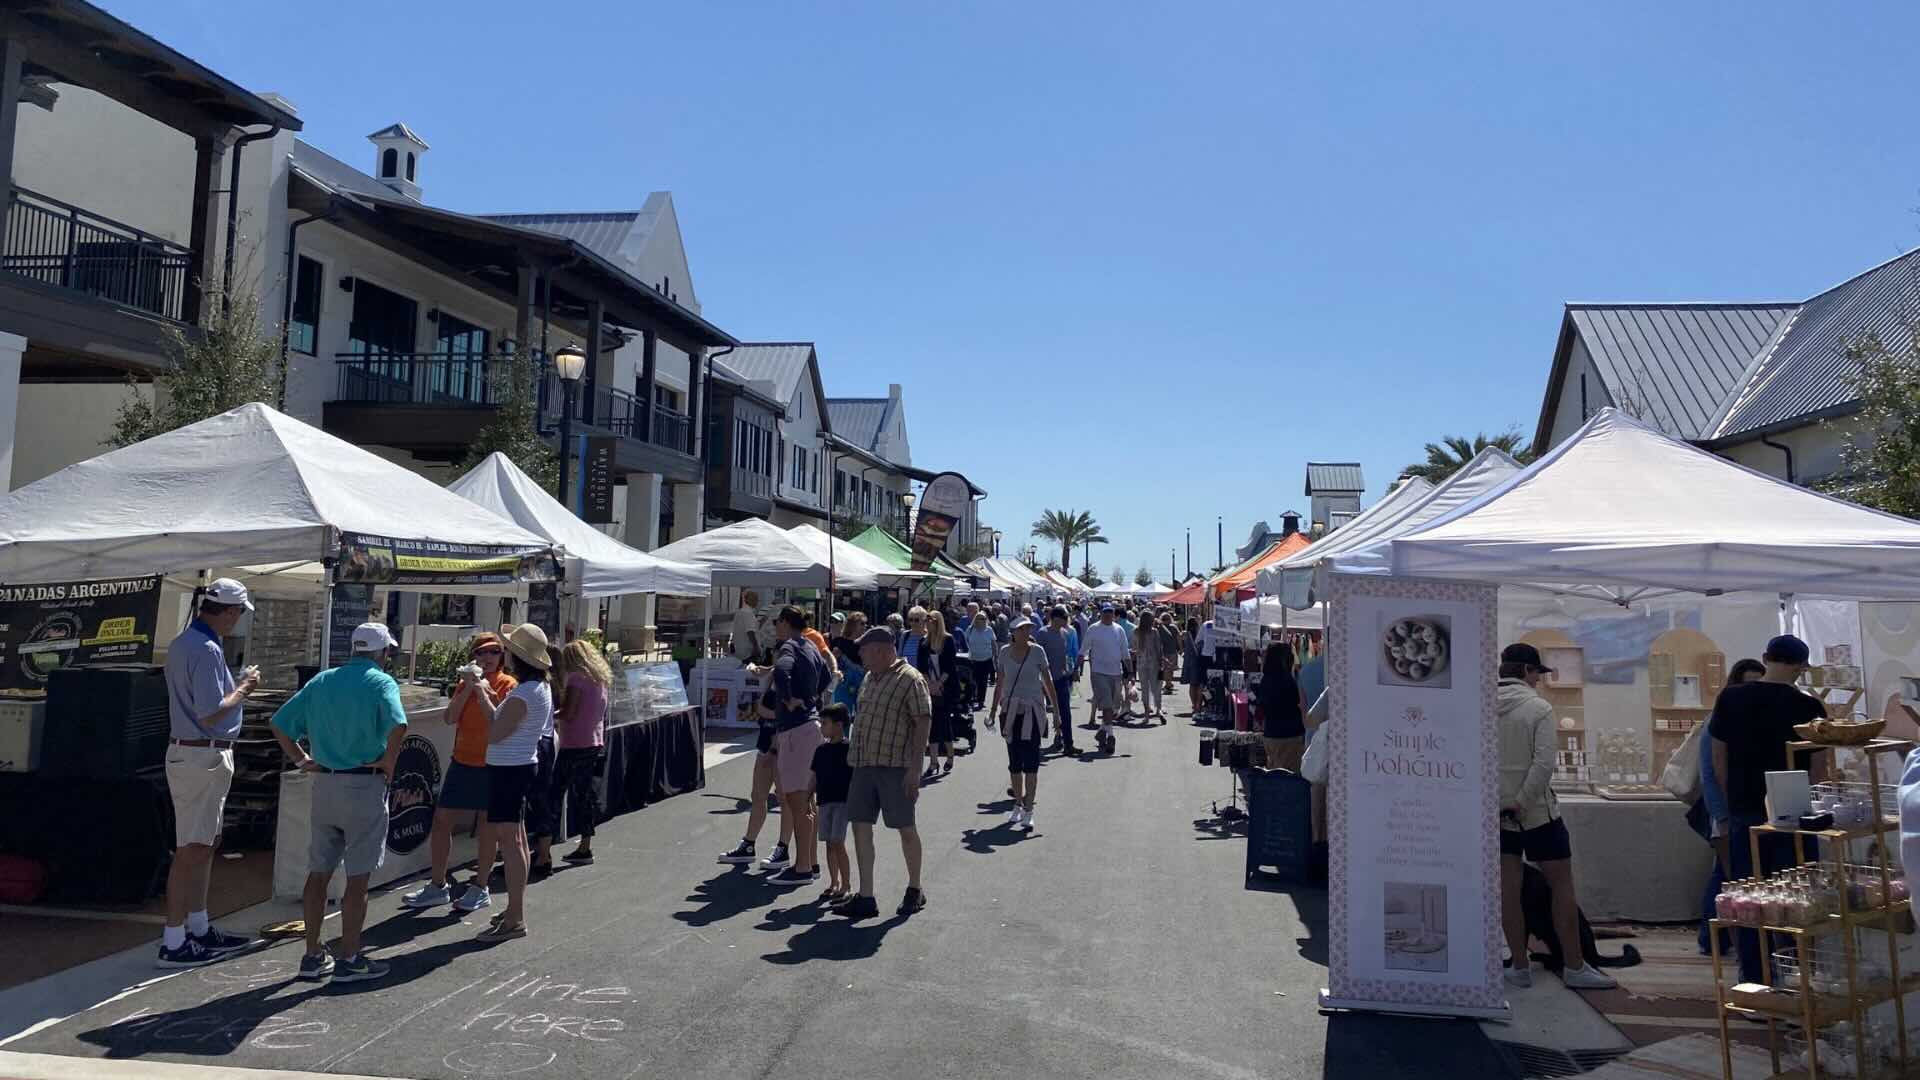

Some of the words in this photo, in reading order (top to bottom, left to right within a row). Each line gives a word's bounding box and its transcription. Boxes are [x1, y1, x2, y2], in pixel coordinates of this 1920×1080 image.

[69, 579, 156, 599] ARGENTINAS
[103, 619, 131, 629] ORDER
[100, 629, 131, 638] ONLINE
[1384, 728, 1447, 752] Simple
